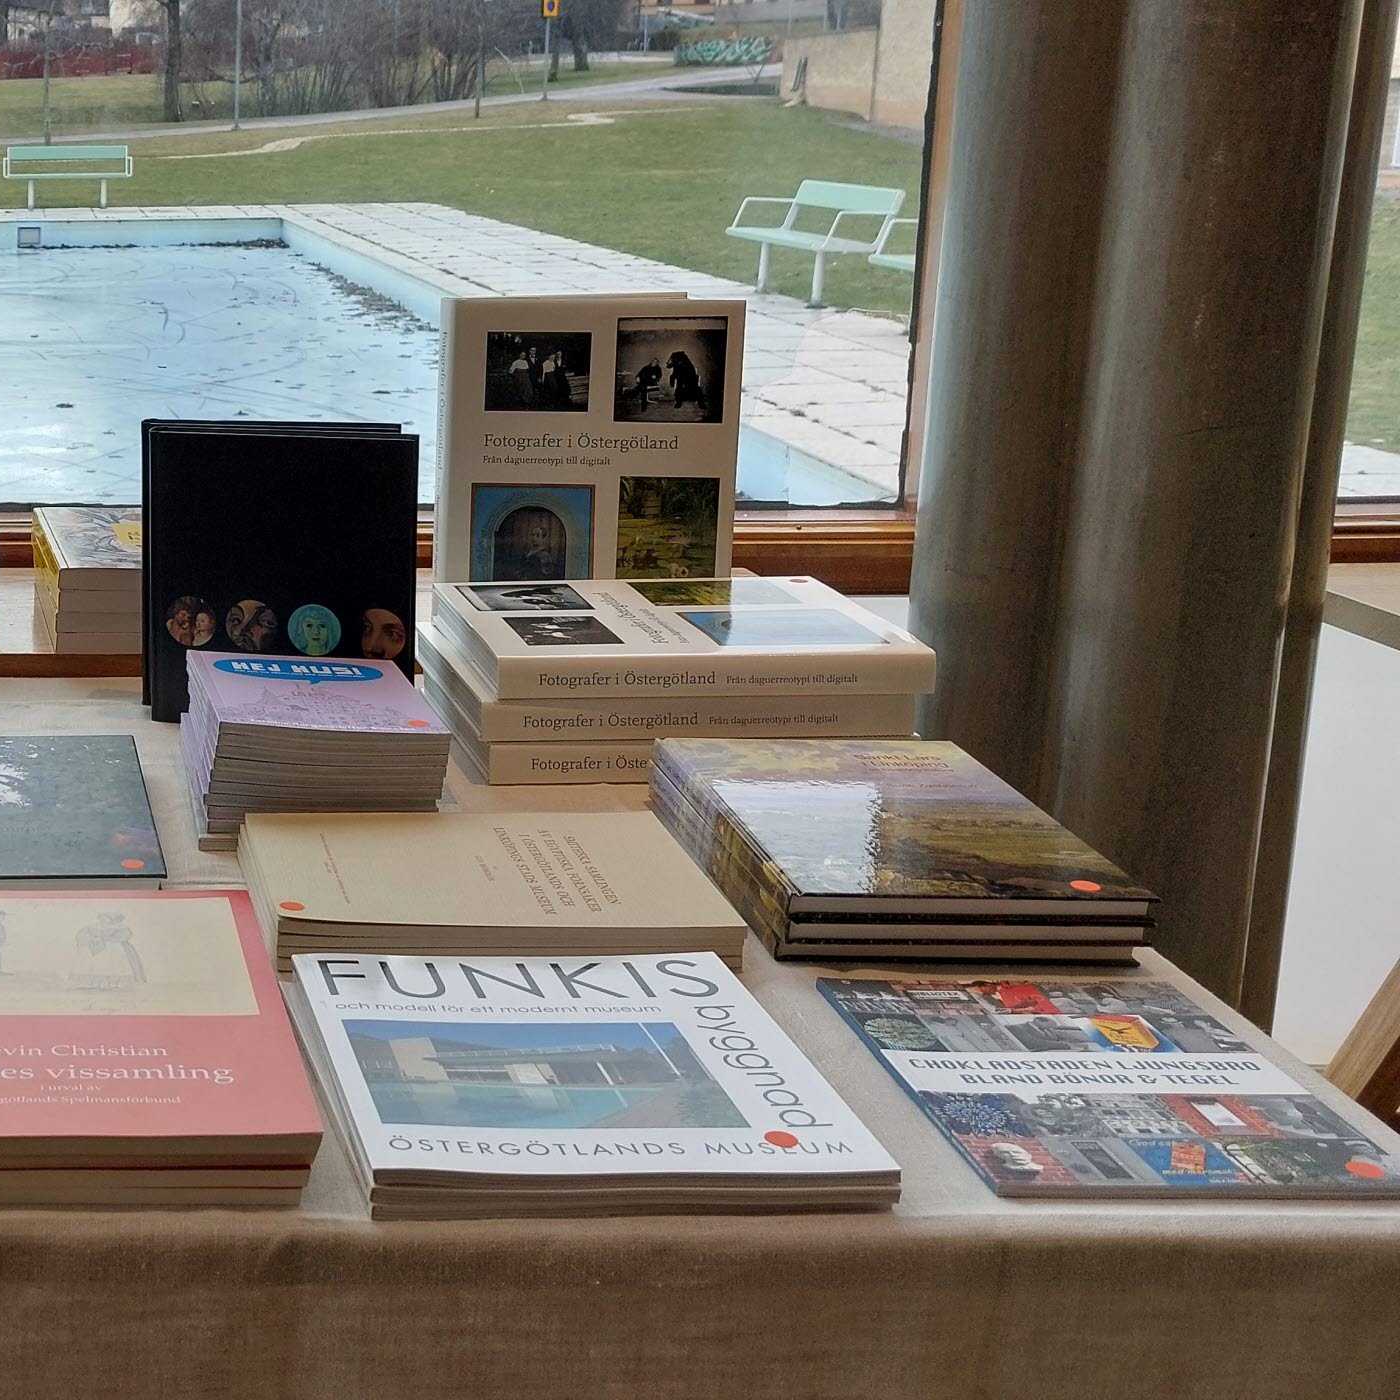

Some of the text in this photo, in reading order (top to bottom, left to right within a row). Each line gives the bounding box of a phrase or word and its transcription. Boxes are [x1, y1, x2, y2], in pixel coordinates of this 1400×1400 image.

[483, 432, 679, 453] Fotografer i Östergötland
[482, 455, 611, 467] Från daguerreotypi till digitalt
[538, 671, 858, 689] Fotografer i Östergötland Från daguerreotypi till digitalt
[523, 713, 839, 732] Fotografer i Östergötland Från daguerreotypi till digitalt
[531, 755, 650, 774] Fotografer i Öste
[556, 890, 576, 907] OCH
[317, 958, 720, 999] FUNKIS
[335, 1002, 662, 1014] och modell för ett modernt museum
[51, 1044, 168, 1057] Christian
[694, 1005, 833, 1129] byggnad
[908, 1057, 1262, 1072] CHOKLADSTADEN LJUNGSBRO
[46, 1064, 235, 1084] vissamling
[959, 1072, 1241, 1085] BLAND BÖNOR & TEGEL
[48, 1083, 84, 1091] urval
[388, 1135, 686, 1157] ÖSTERGÖTLANDS
